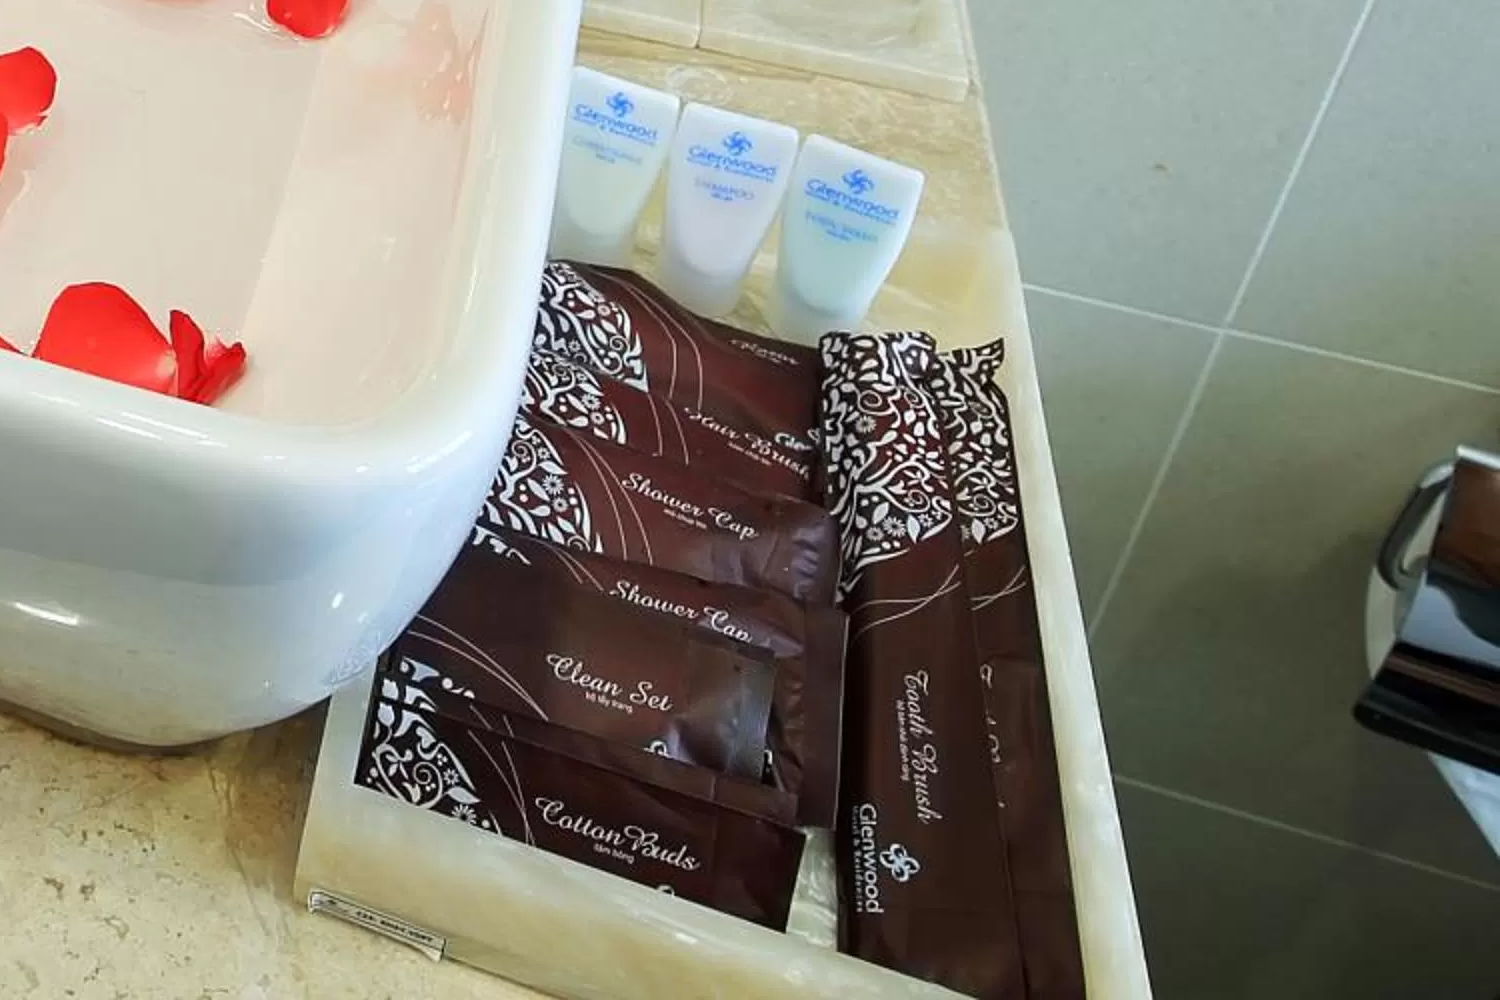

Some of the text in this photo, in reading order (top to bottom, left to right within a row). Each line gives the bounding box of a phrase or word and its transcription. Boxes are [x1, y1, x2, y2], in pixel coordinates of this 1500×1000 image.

[686, 145, 777, 178] Glenwood
[621, 472, 705, 517] Shower
[707, 506, 759, 541] Cap
[609, 579, 699, 619] Shower
[547, 653, 623, 697] Clean
[630, 681, 672, 712] Set
[903, 669, 934, 738] Tooth
[911, 743, 943, 825] Brush
[535, 797, 701, 871] Cotton Buds
[860, 803, 885, 913] Glenwood
